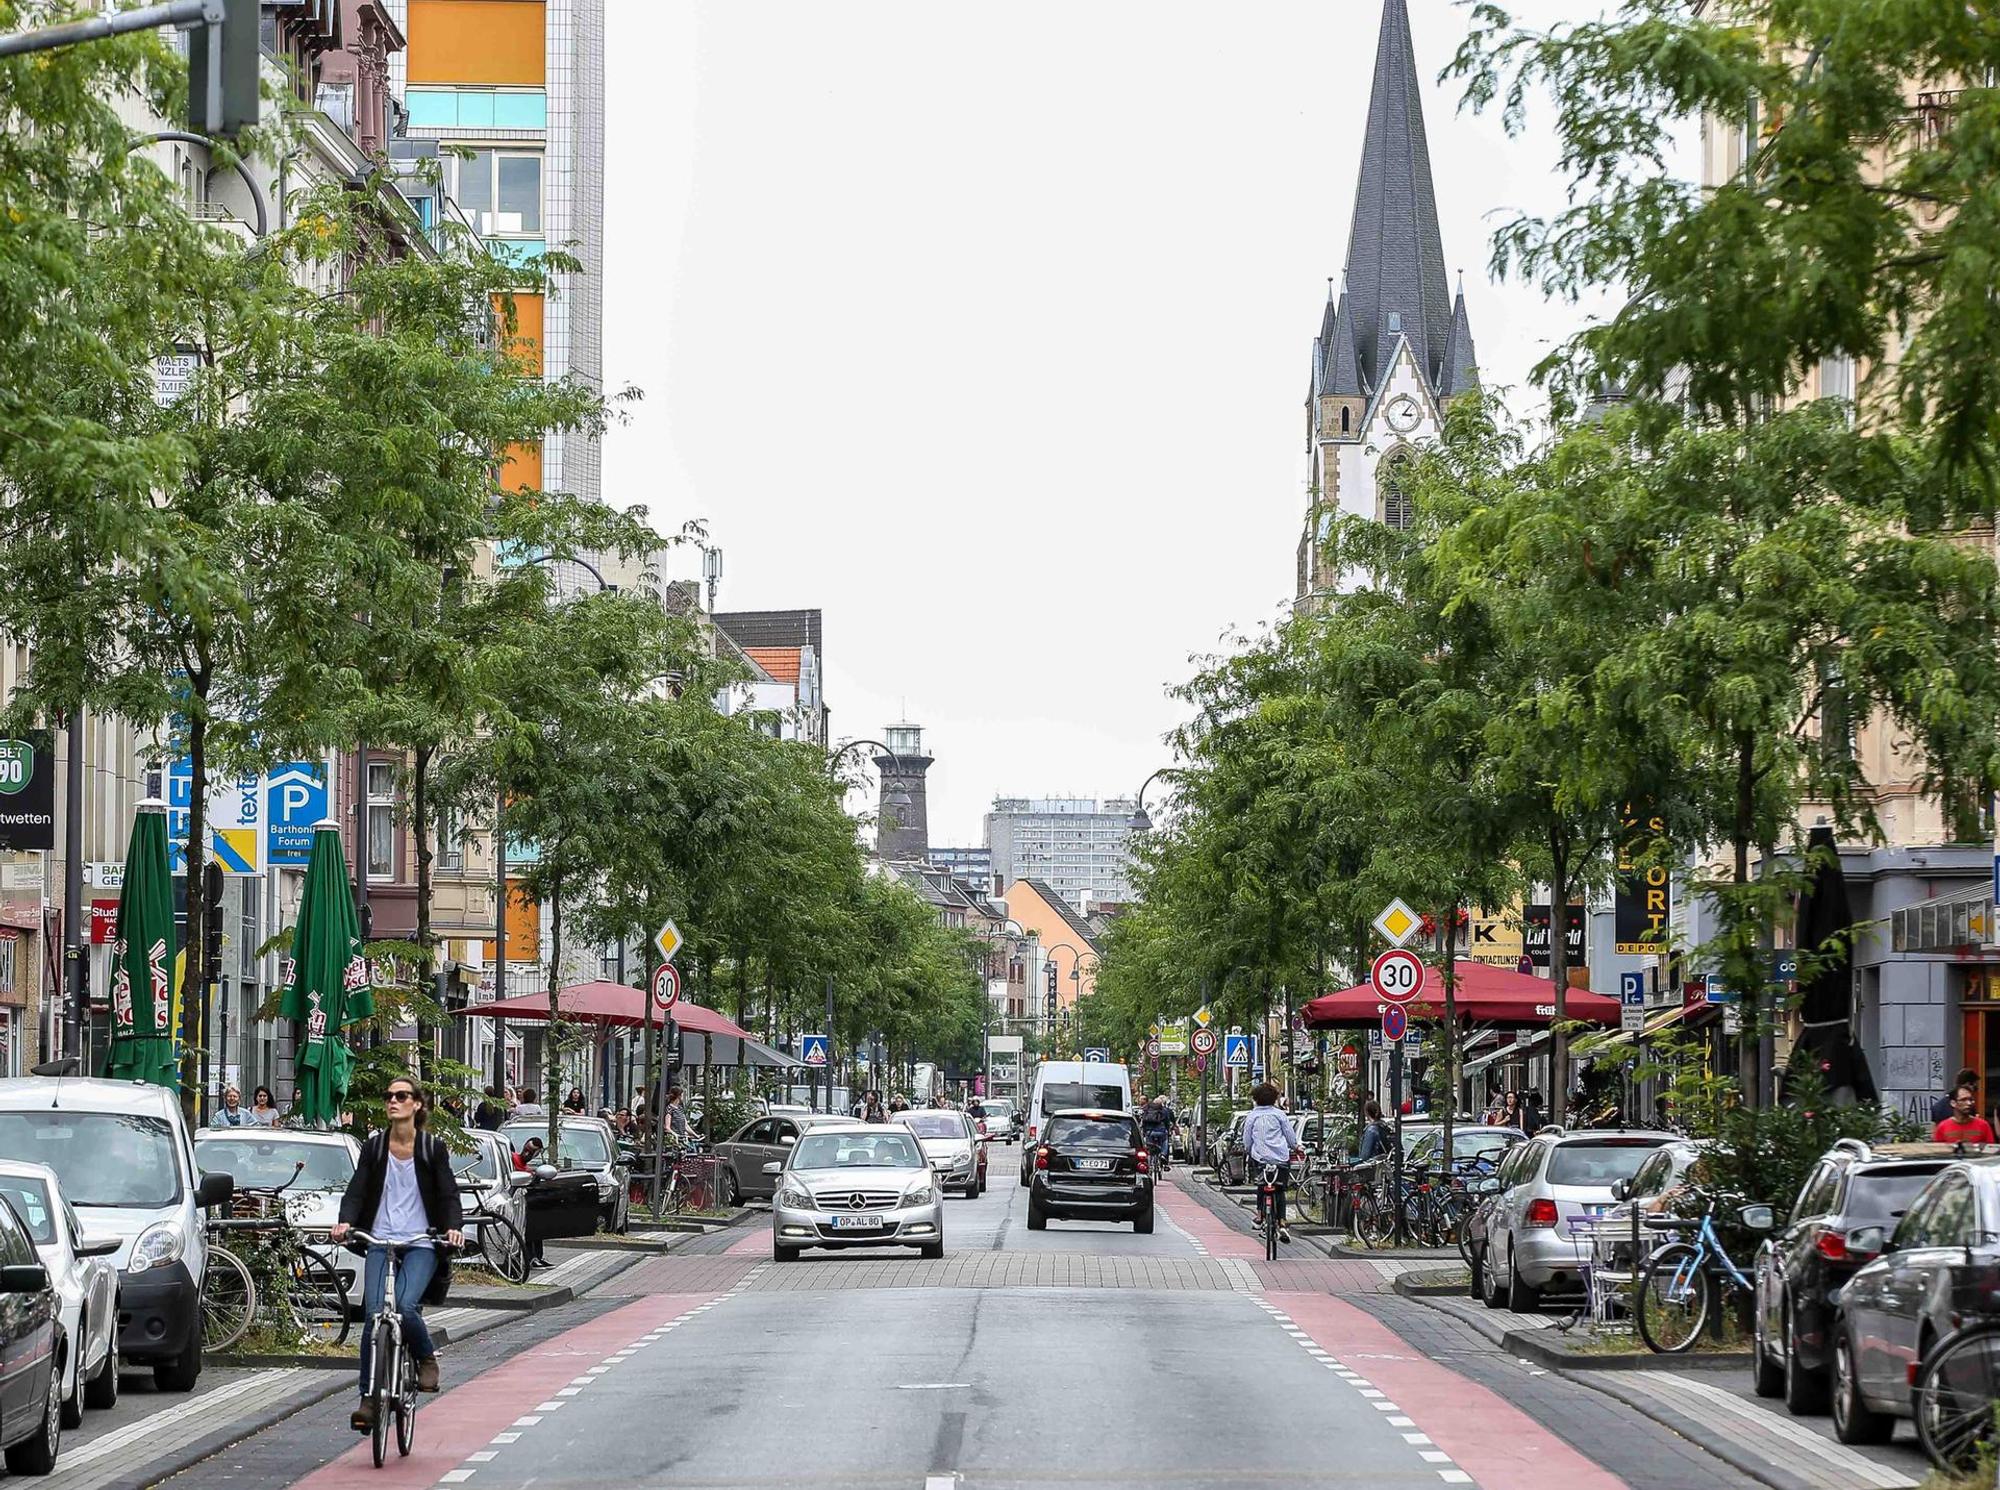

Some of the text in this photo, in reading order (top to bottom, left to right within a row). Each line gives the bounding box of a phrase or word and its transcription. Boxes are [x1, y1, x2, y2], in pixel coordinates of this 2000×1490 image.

[283, 785, 310, 822] P
[278, 837, 310, 846] Forum
[92, 907, 118, 917] Studi
[1383, 964, 1413, 987] 30
[658, 977, 674, 998] 30
[1197, 1036, 1211, 1047] 30
